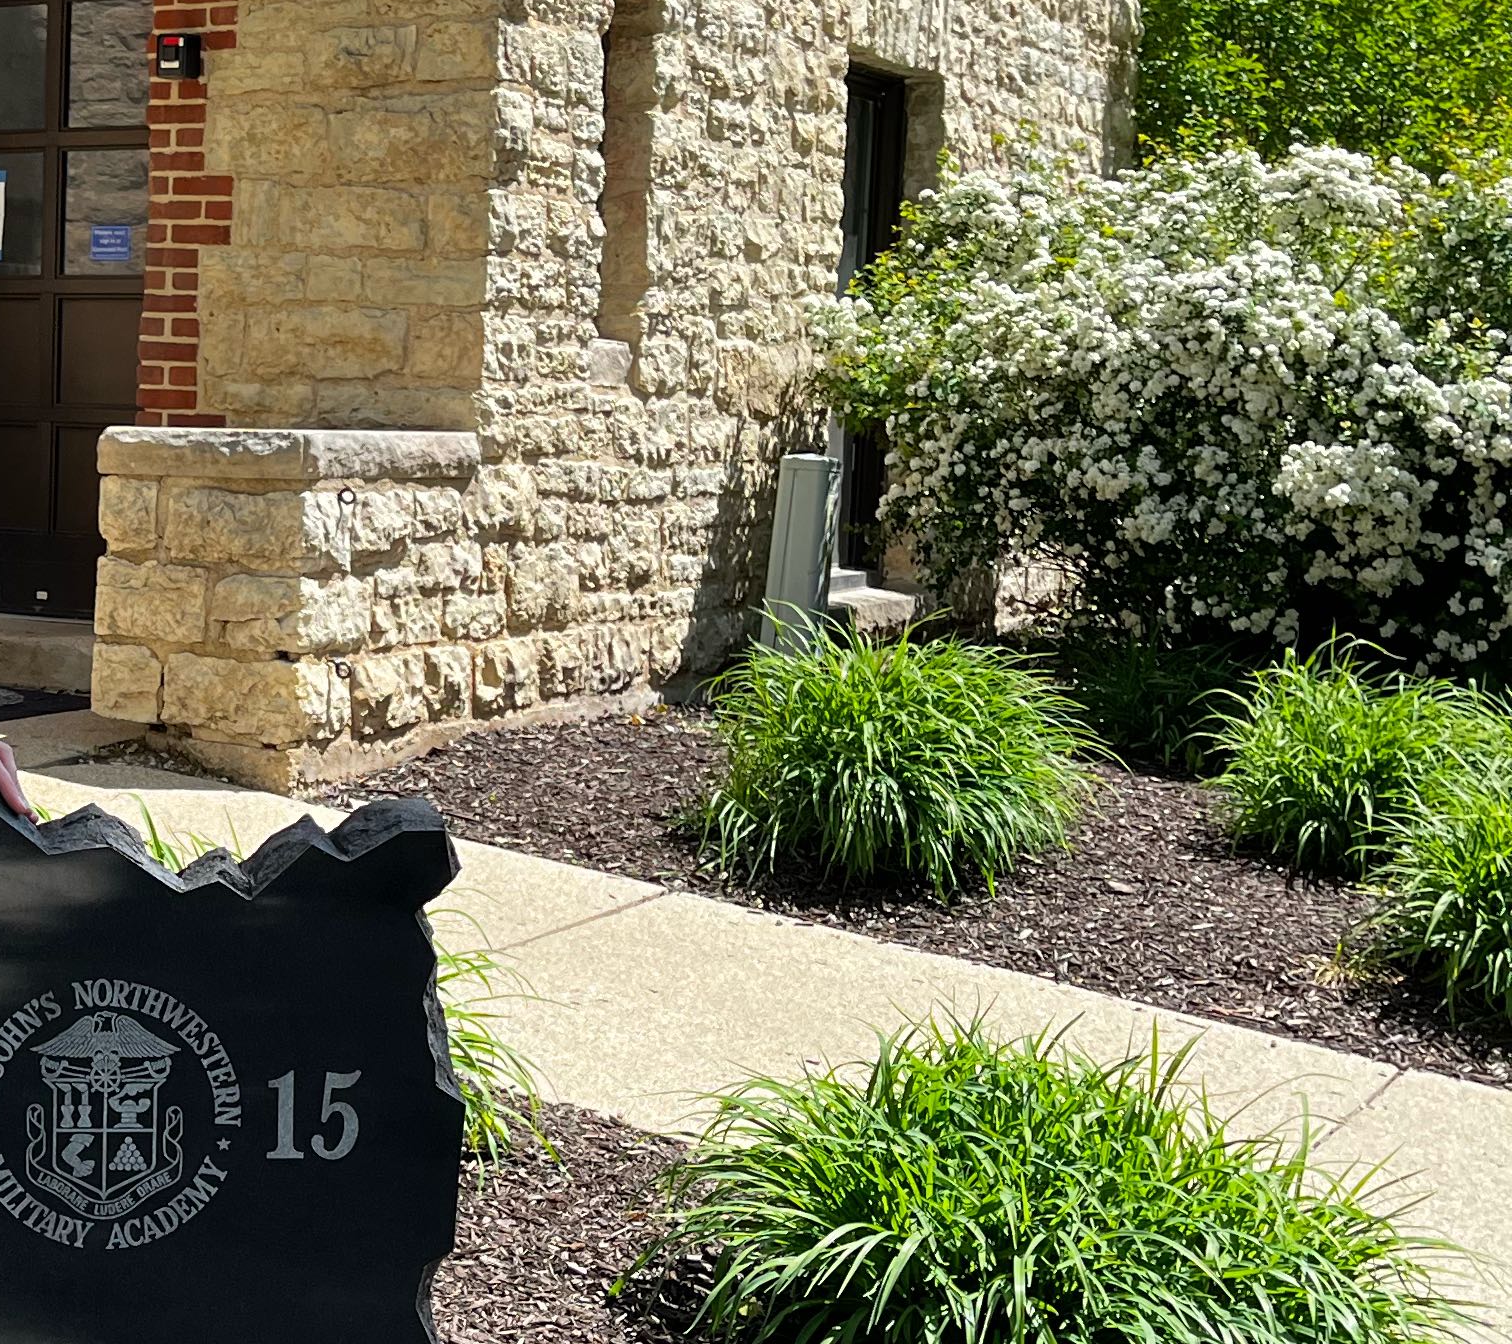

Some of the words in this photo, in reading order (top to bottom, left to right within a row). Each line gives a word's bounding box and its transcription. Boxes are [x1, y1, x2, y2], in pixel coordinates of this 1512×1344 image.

[71, 978, 242, 1128] NORTHWESTERN
[266, 1069, 362, 1160] 15
[37, 1172, 88, 1211] LABORARE
[94, 1195, 136, 1216] LUDERE
[105, 1155, 228, 1250] ACADEMY
